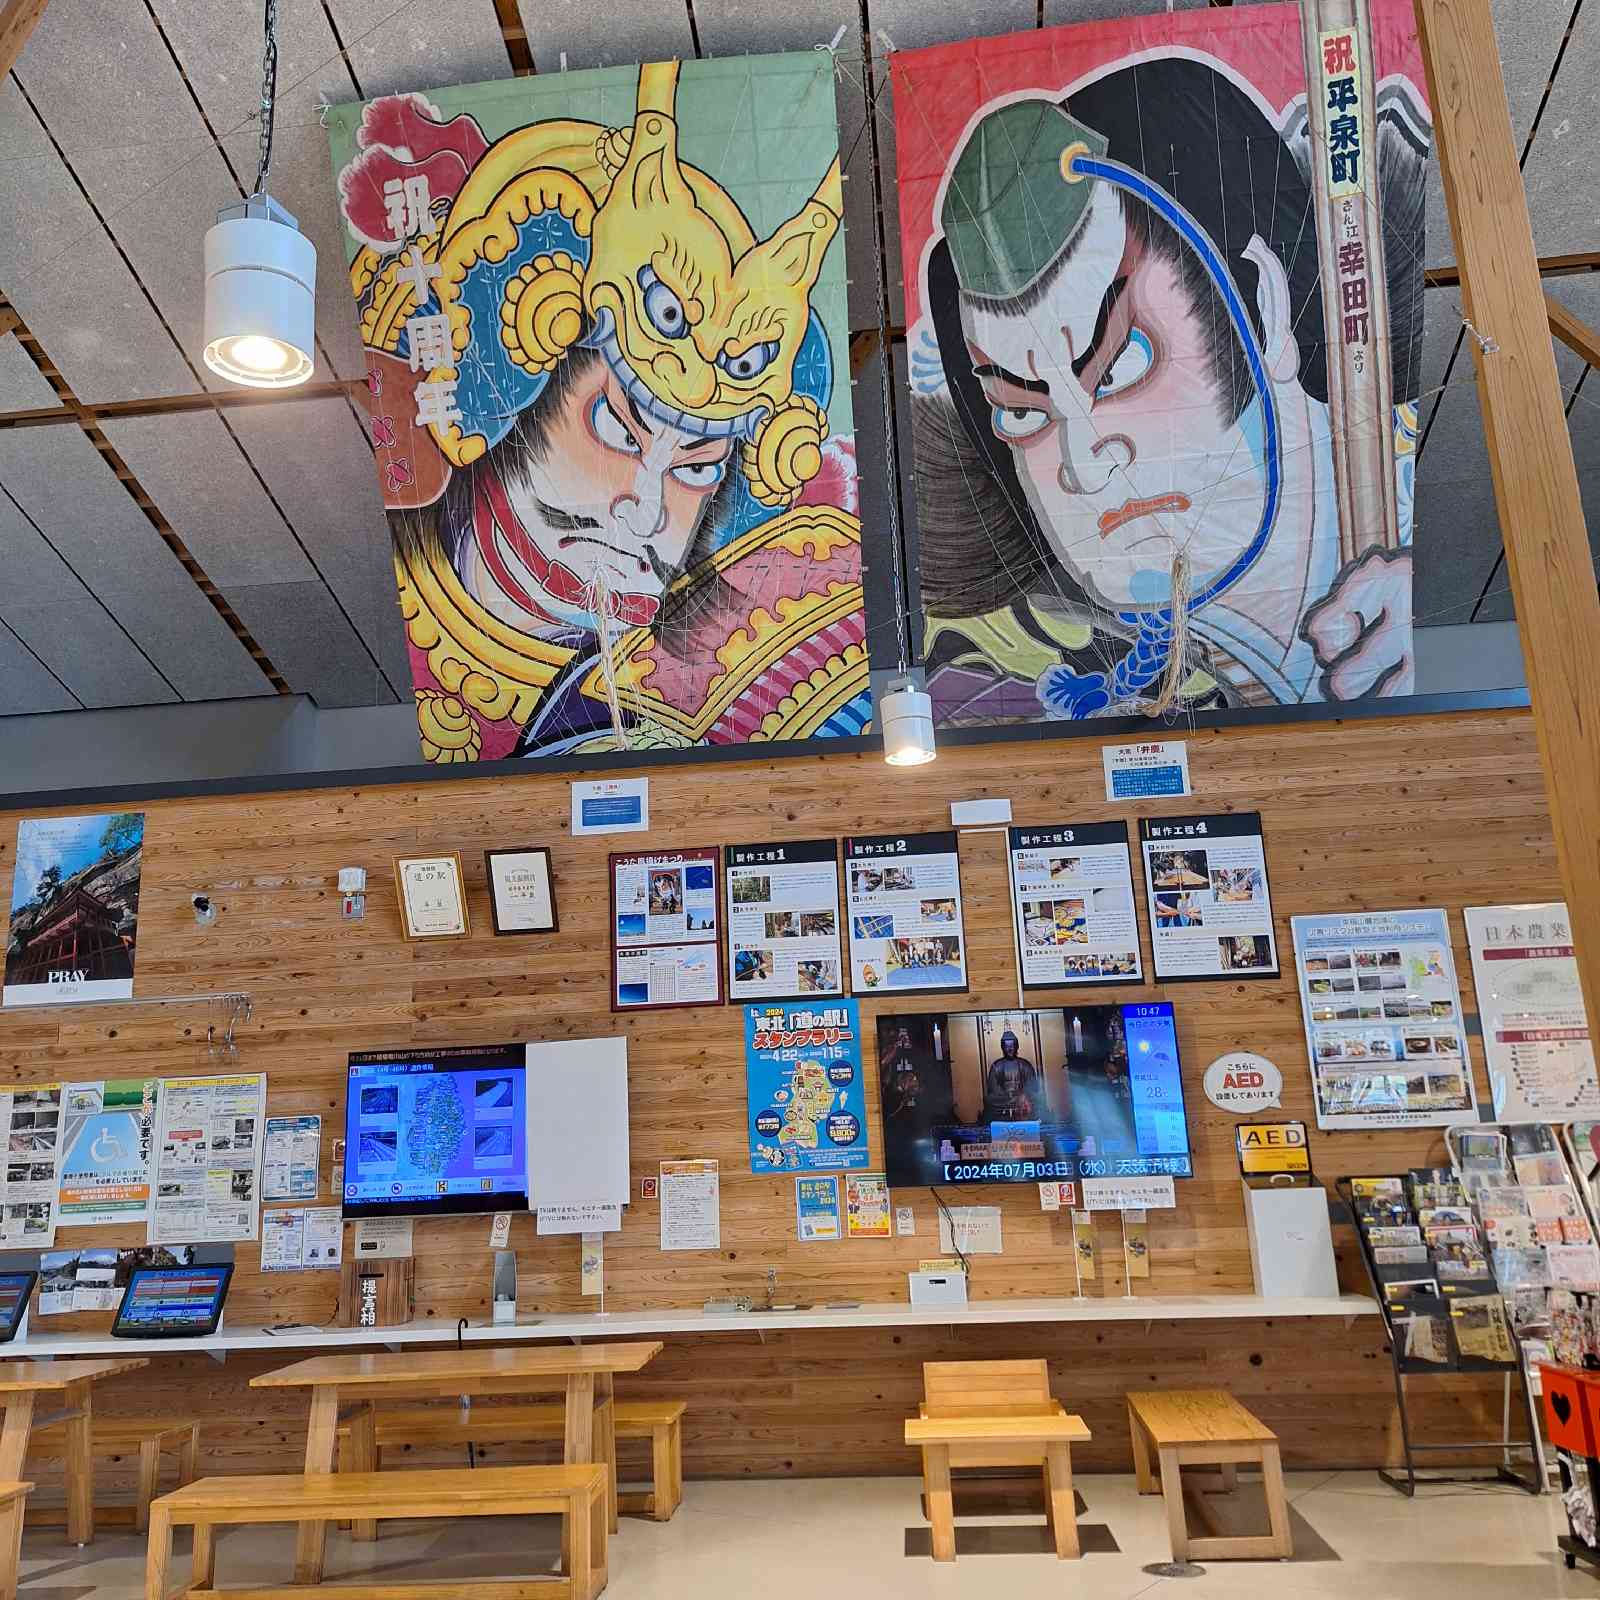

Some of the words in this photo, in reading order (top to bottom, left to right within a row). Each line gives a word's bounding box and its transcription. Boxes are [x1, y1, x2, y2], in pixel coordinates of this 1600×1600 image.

[1338, 240, 1370, 347] 幸田町
[383, 175, 464, 436] 祝十周年
[1020, 830, 1075, 845] 製作工程3
[1151, 822, 1208, 837] 製作工程4
[854, 840, 908, 855] 製作工程2
[736, 849, 786, 863] 製作工程1
[1485, 922, 1569, 943] 日本農業
[48, 969, 89, 985] PRAY
[766, 1008, 784, 1017] 2024
[756, 1016, 786, 1032] 東北
[753, 1027, 854, 1050] スタンプラリー
[1227, 1063, 1257, 1072] こちらに
[1223, 1072, 1264, 1089] AED
[1215, 1090, 1275, 1101] 設置してあります
[1245, 1129, 1302, 1146] AED
